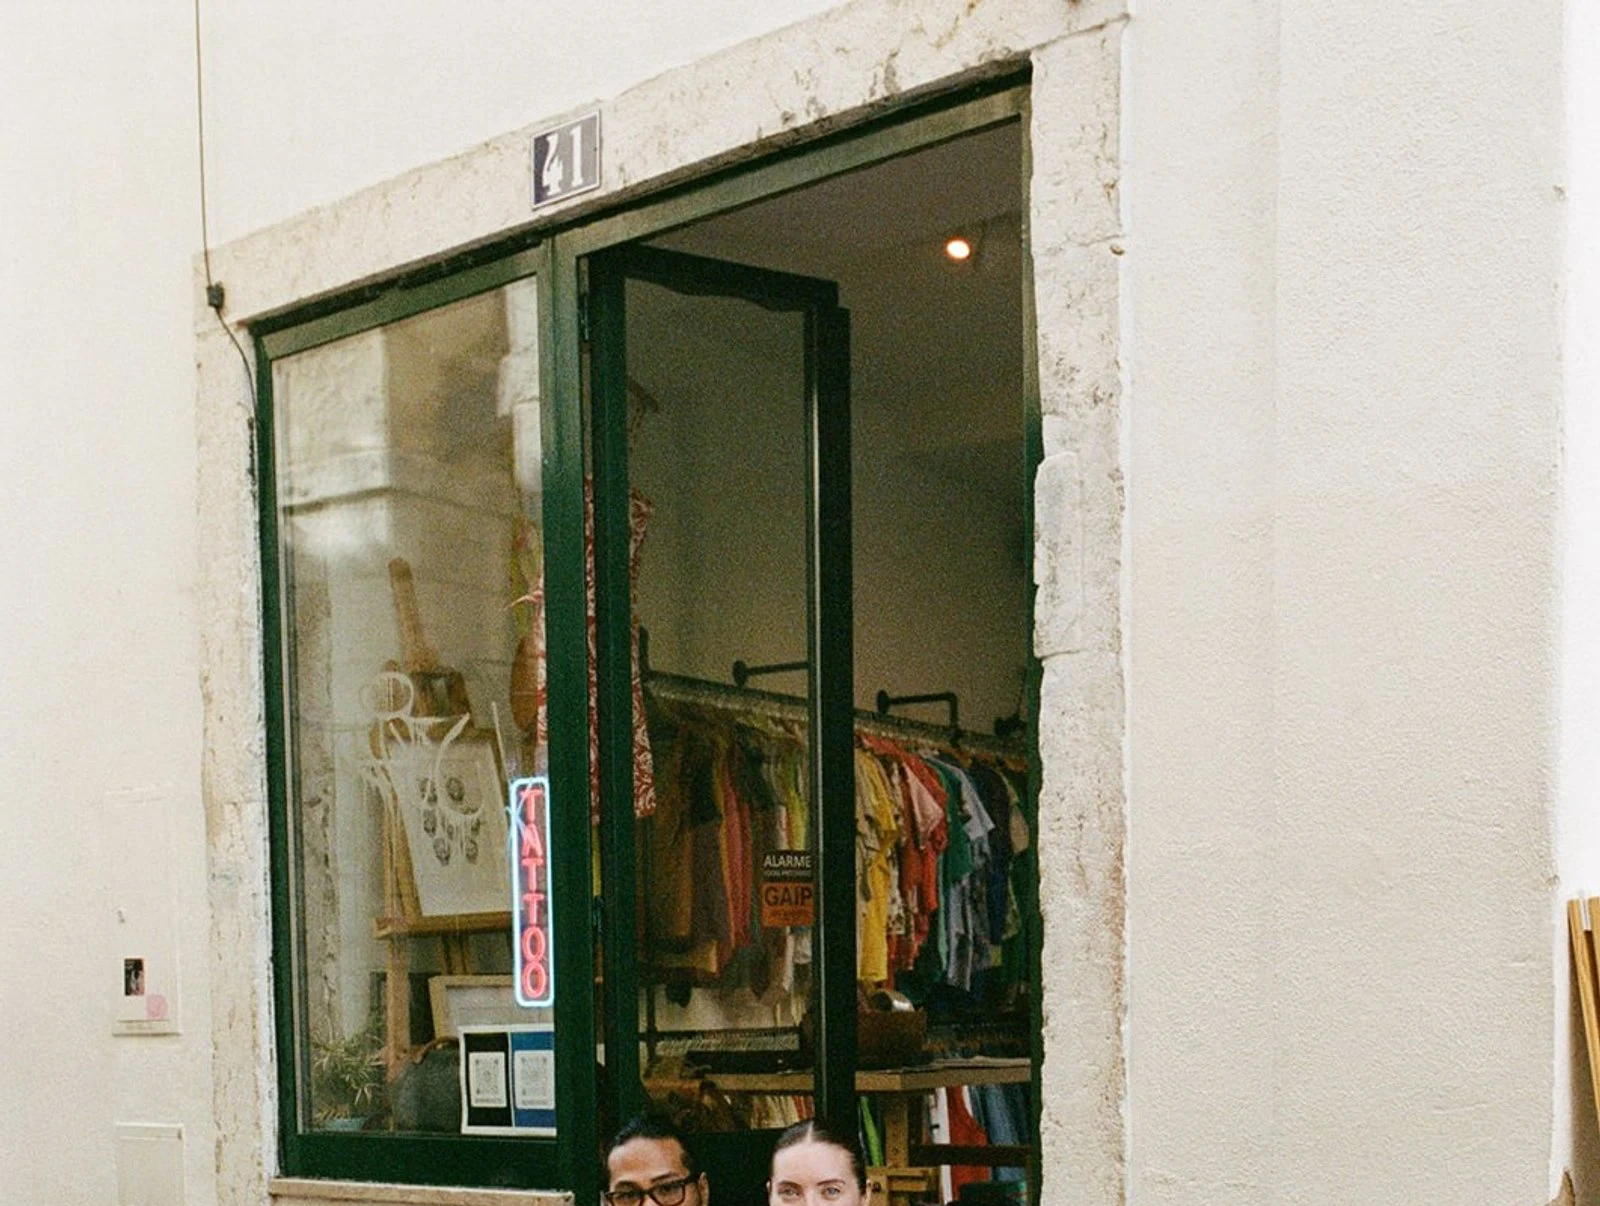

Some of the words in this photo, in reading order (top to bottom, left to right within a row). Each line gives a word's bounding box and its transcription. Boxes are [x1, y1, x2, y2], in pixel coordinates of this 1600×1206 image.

[542, 125, 583, 196] 41
[519, 788, 547, 998] TATTOO
[763, 855, 812, 868] ALARME
